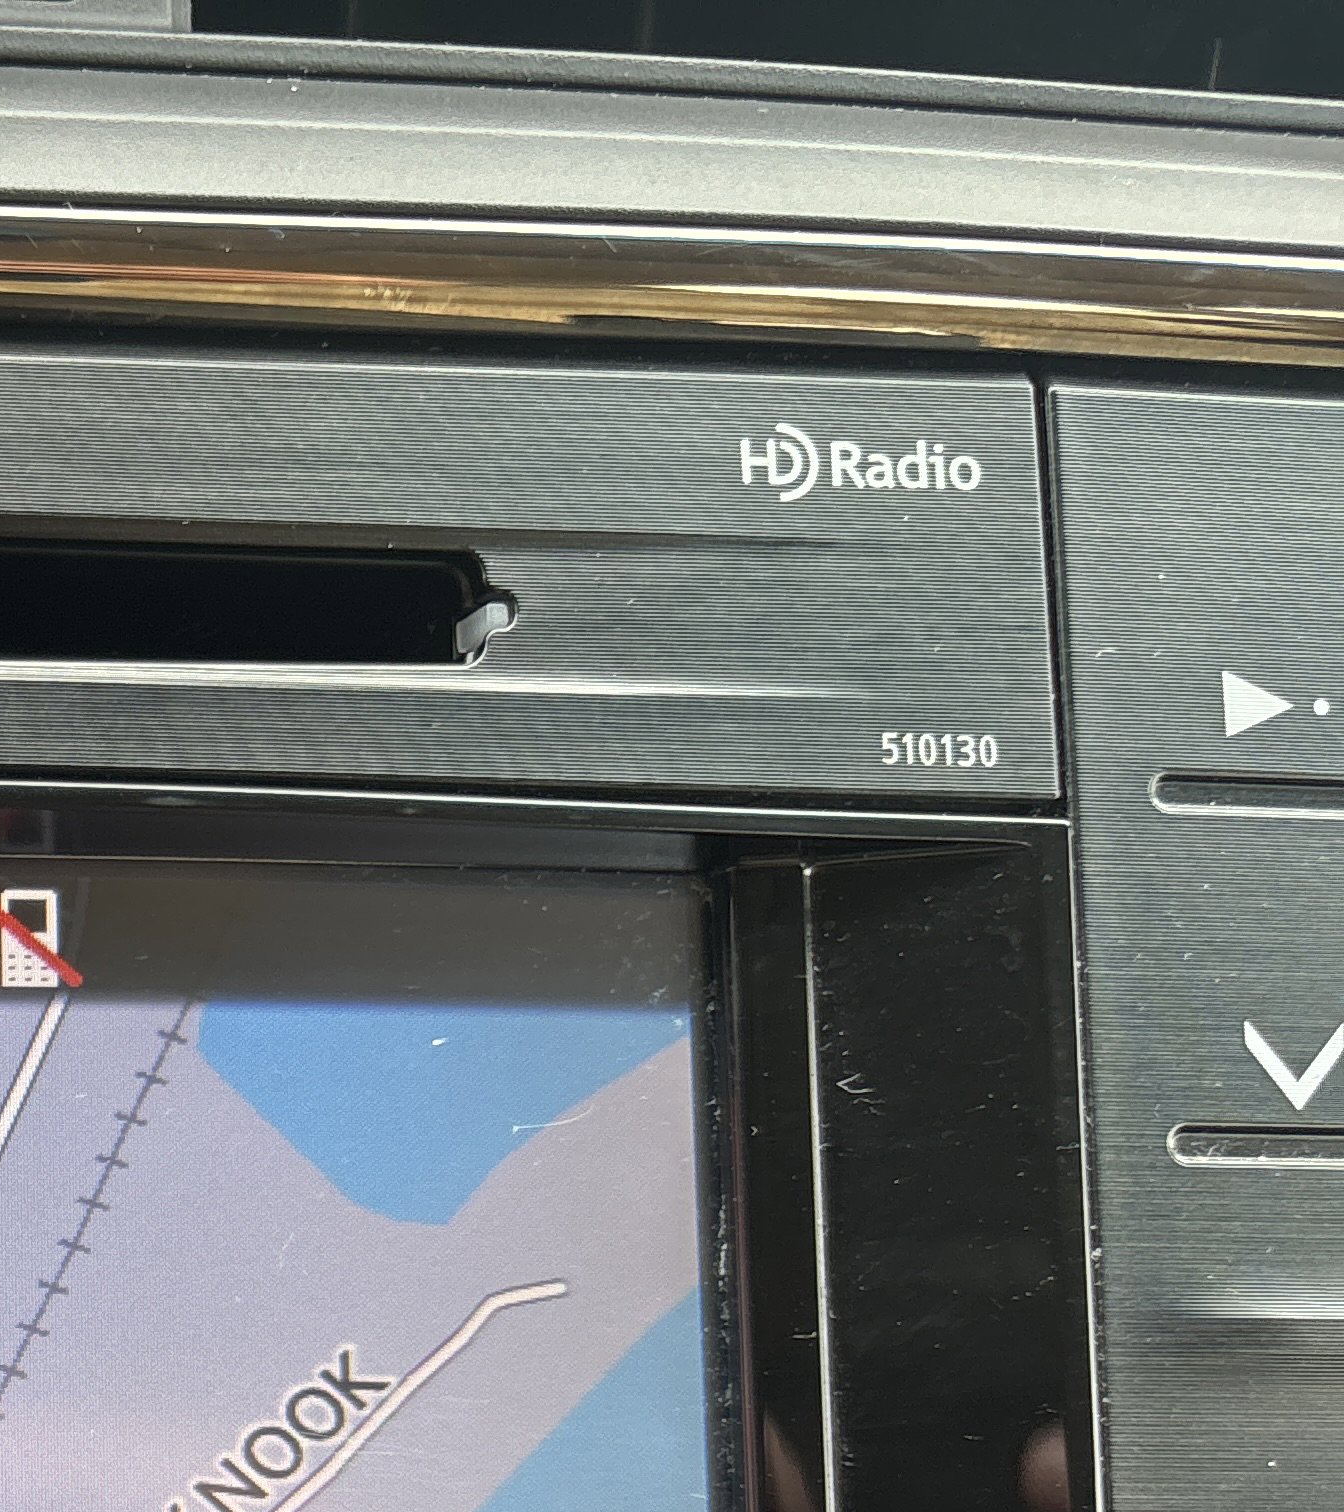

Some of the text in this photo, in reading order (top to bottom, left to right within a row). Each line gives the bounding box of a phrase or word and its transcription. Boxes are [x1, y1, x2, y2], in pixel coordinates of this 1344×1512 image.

[739, 423, 981, 502] HD Radio
[881, 732, 999, 768] 510130
